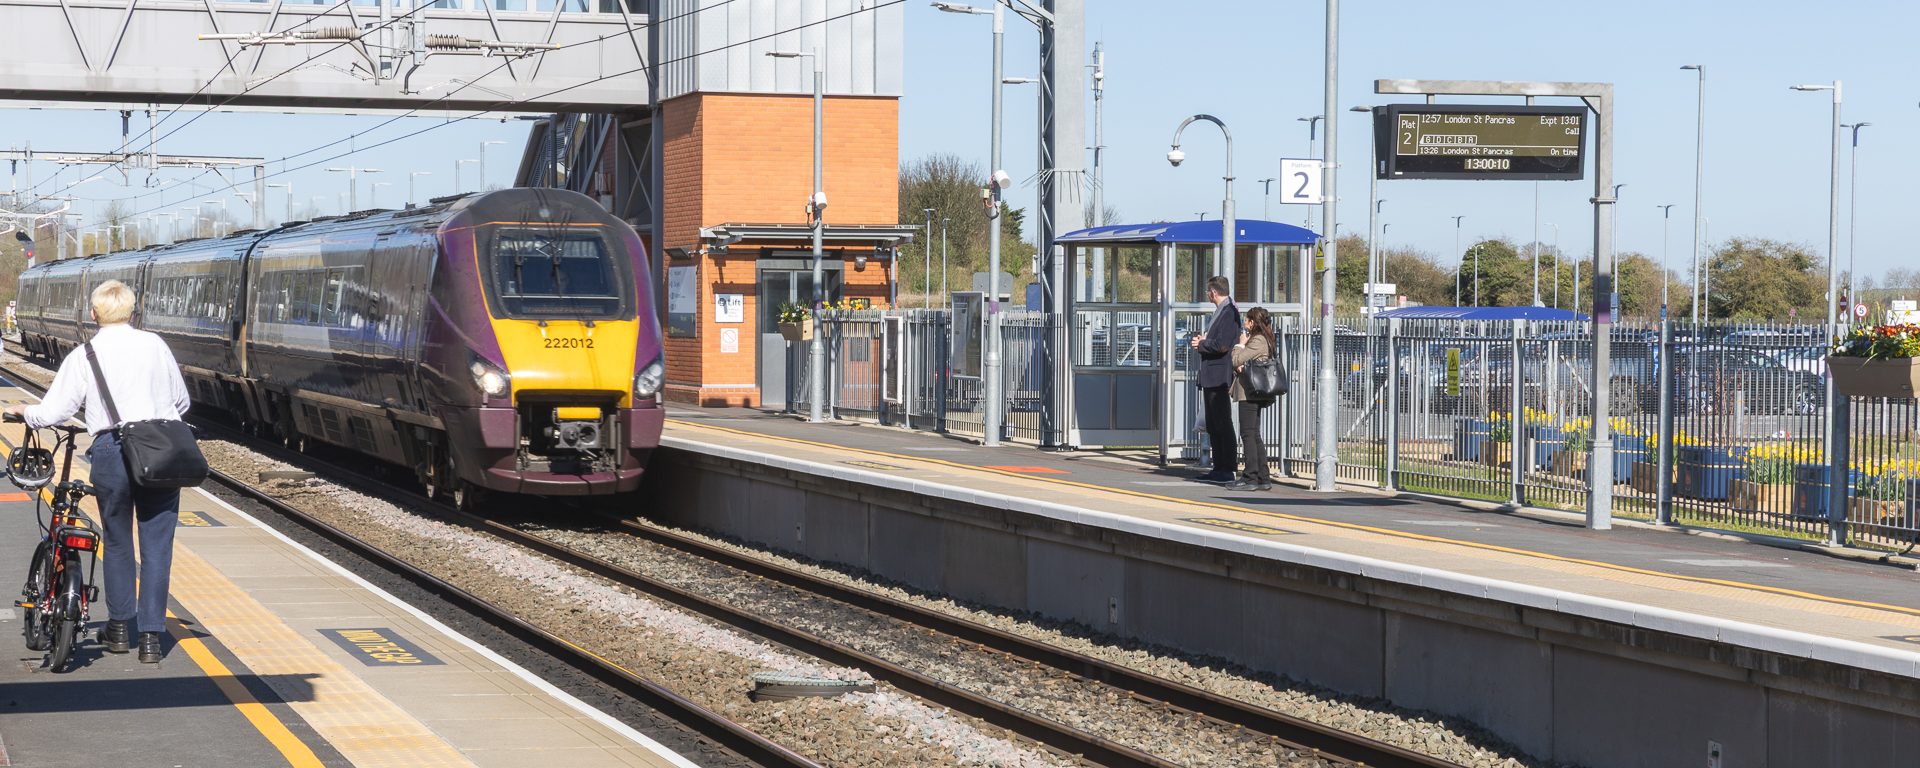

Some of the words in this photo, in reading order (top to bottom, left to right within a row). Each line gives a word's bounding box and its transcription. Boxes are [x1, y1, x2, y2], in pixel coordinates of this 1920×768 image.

[1401, 120, 1416, 129] Plat
[1422, 115, 1441, 123] 12:57
[1444, 115, 1471, 123] London
[1474, 115, 1482, 123] St
[1485, 115, 1515, 124] Pancras
[1541, 116, 1557, 127] Expt
[1561, 116, 1579, 125] 13:01
[1403, 132, 1412, 145] 2
[1467, 158, 1509, 170] 13:00:10
[1293, 171, 1309, 198] 2
[544, 338, 594, 349] 222012
